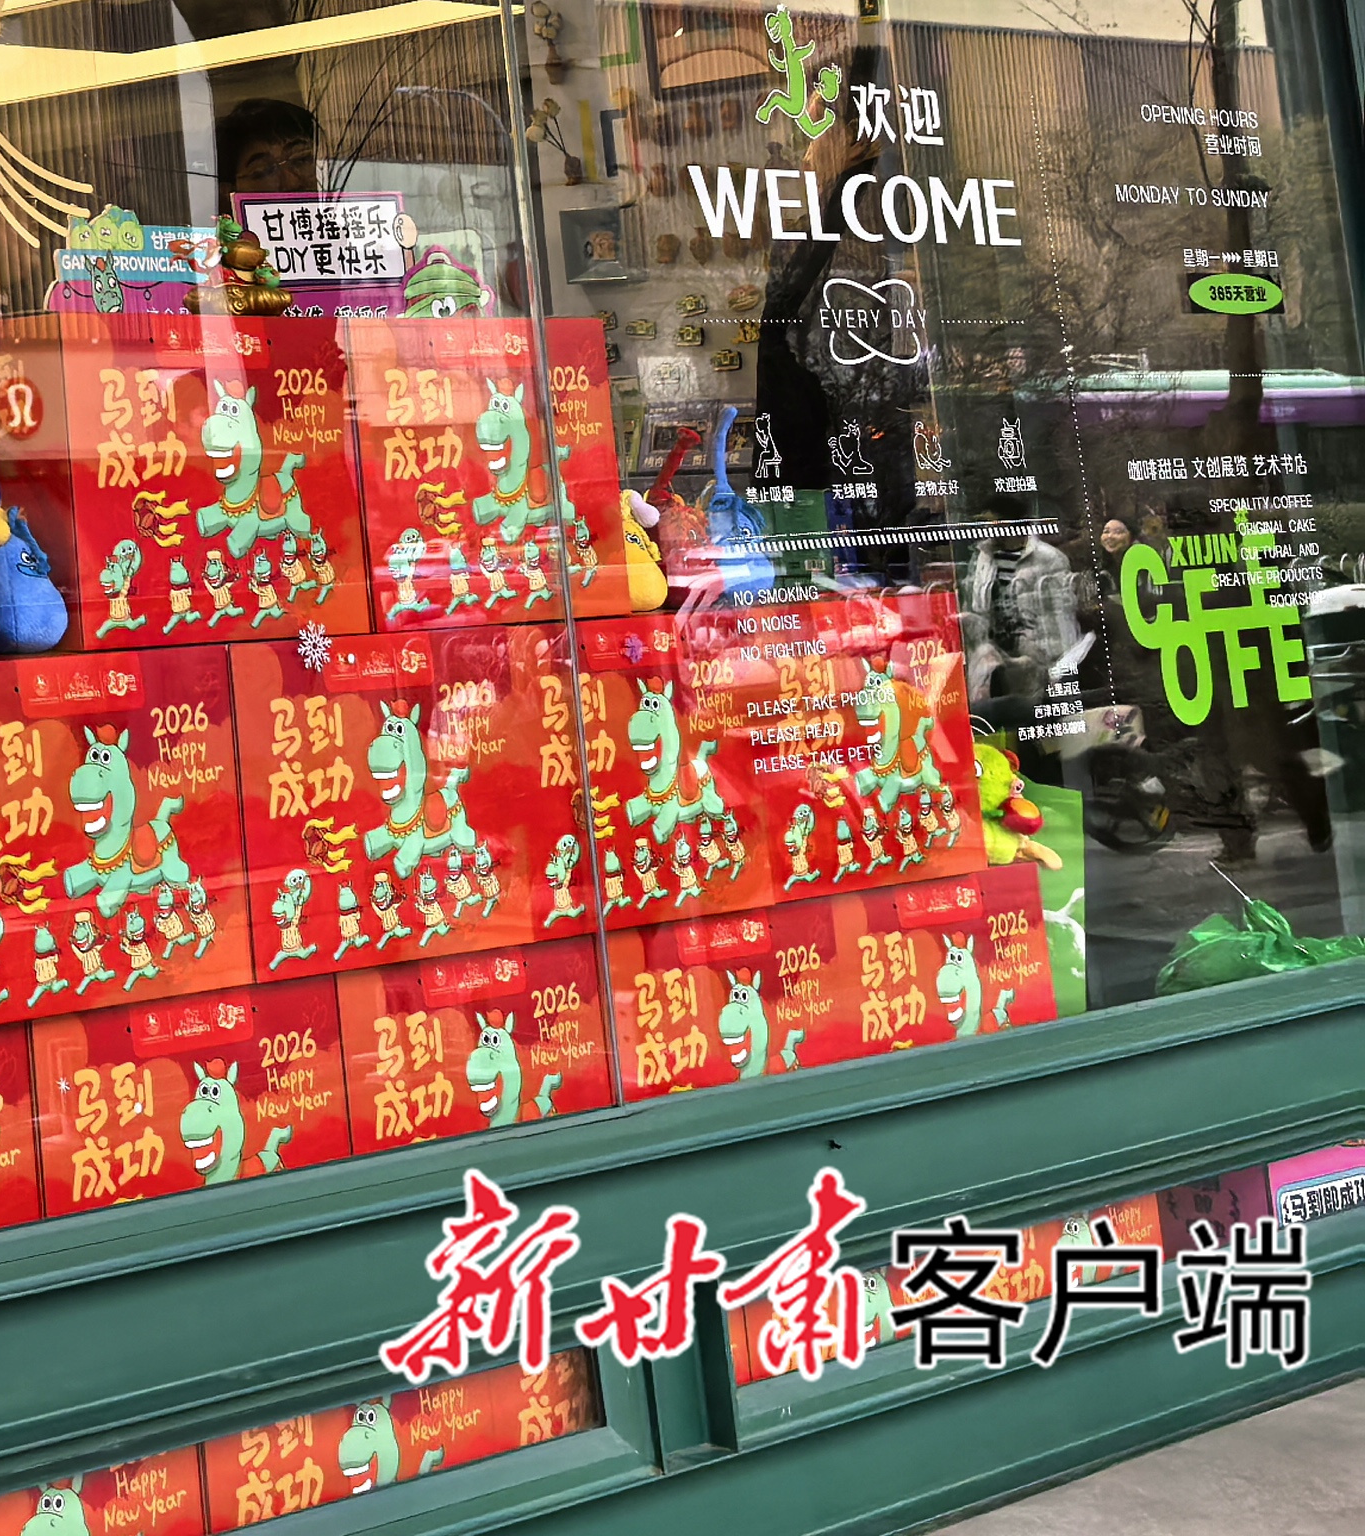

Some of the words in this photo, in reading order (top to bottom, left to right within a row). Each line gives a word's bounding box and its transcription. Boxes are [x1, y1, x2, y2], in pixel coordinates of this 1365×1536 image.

[849, 81, 945, 146] 欢迎
[1140, 104, 1206, 126] OPENING
[1209, 109, 1259, 130] HOURS
[1205, 133, 1262, 157] 营业时间
[687, 164, 1022, 247] WELCOME
[1115, 183, 1180, 205] MONDAY
[1185, 187, 1208, 206] TO
[1212, 189, 1270, 208] SUNDAY
[262, 205, 390, 241] 甘博摇摇乐
[113, 255, 187, 272] PROVINCIAL
[274, 241, 387, 275] DIY更快乐
[1209, 285, 1268, 302] 365天营业
[820, 308, 880, 329] EVERY
[891, 308, 928, 329] DAY
[274, 367, 328, 397] 2026
[98, 368, 178, 430] 马到
[384, 368, 454, 426] 马到
[282, 400, 326, 427] Happy
[273, 425, 305, 445] New
[307, 425, 344, 452] Year
[97, 431, 188, 488] 成功
[384, 427, 464, 481] 成功
[1127, 457, 1188, 481] 咖啡甜品
[1191, 455, 1249, 479] 文创展览
[1252, 453, 1308, 477] 艺术书店
[745, 485, 795, 503] 禁止吸烟
[831, 482, 878, 500] 无线网络
[914, 479, 960, 497] 宠物友好
[993, 475, 1038, 493] 欢迎拍摄
[1209, 496, 1270, 513] SPECIALITY
[1272, 494, 1314, 510] COFFEE
[1238, 519, 1287, 536] ORIGINAL
[1288, 517, 1317, 534] CAKE
[1240, 544, 1297, 561] CULTURAL
[1299, 542, 1320, 557] AND
[1210, 571, 1263, 588] CREATIVE
[1266, 566, 1324, 585] PRODUCTS
[733, 589, 754, 607] NO
[757, 584, 819, 604] SMOKING
[1269, 591, 1327, 608] BOOKSHOP
[736, 617, 757, 635] NO
[761, 613, 801, 632] NOISE
[740, 645, 762, 662] NO
[765, 639, 827, 659] FIGHTING
[906, 639, 946, 666] 2026
[688, 658, 735, 687] 2026
[438, 679, 495, 712] 2026
[540, 672, 606, 729] 马到
[695, 687, 734, 710] Happy
[747, 697, 799, 718] PLEASE
[801, 693, 838, 713] TAKE
[840, 686, 897, 709] PHOTOS
[1045, 681, 1081, 698] 七里河区
[150, 701, 209, 738] 2026
[1033, 700, 1084, 719] 西津西路3号
[270, 695, 344, 757] 马到
[446, 712, 490, 738] Happy
[750, 726, 803, 746] PLEASE
[807, 721, 841, 740] READ
[158, 737, 206, 761] Happy
[540, 729, 616, 787] 成功
[753, 754, 809, 775] PLEASE
[810, 750, 846, 769] TAKE
[847, 744, 884, 764] PETS
[147, 766, 183, 790] New
[184, 764, 224, 793] Year
[268, 755, 355, 820] 成功
[987, 909, 1030, 941] 2026
[775, 943, 821, 978] 2026
[857, 929, 917, 989] 马到
[994, 940, 1029, 961] Happy
[530, 981, 580, 1018] 2026
[633, 967, 698, 1031] 马到
[782, 976, 820, 999] Happy
[775, 1001, 805, 1022] New
[804, 996, 834, 1023] Year
[861, 983, 927, 1043] 成功
[537, 1015, 579, 1042] Happy
[258, 1027, 317, 1068] 2026
[375, 1010, 443, 1079] 马到
[530, 1043, 562, 1067] New
[561, 1039, 596, 1069] Year
[635, 1024, 709, 1088] 成功
[266, 1065, 314, 1093] Happy
[72, 1061, 155, 1135] 马到
[256, 1094, 291, 1120] New
[291, 1088, 333, 1122] Year
[374, 1077, 454, 1141] 成功
[71, 1126, 165, 1203] 成功
[419, 1386, 464, 1414] Happy
[114, 1467, 168, 1499] Happy
[235, 1456, 324, 1527] 成功
